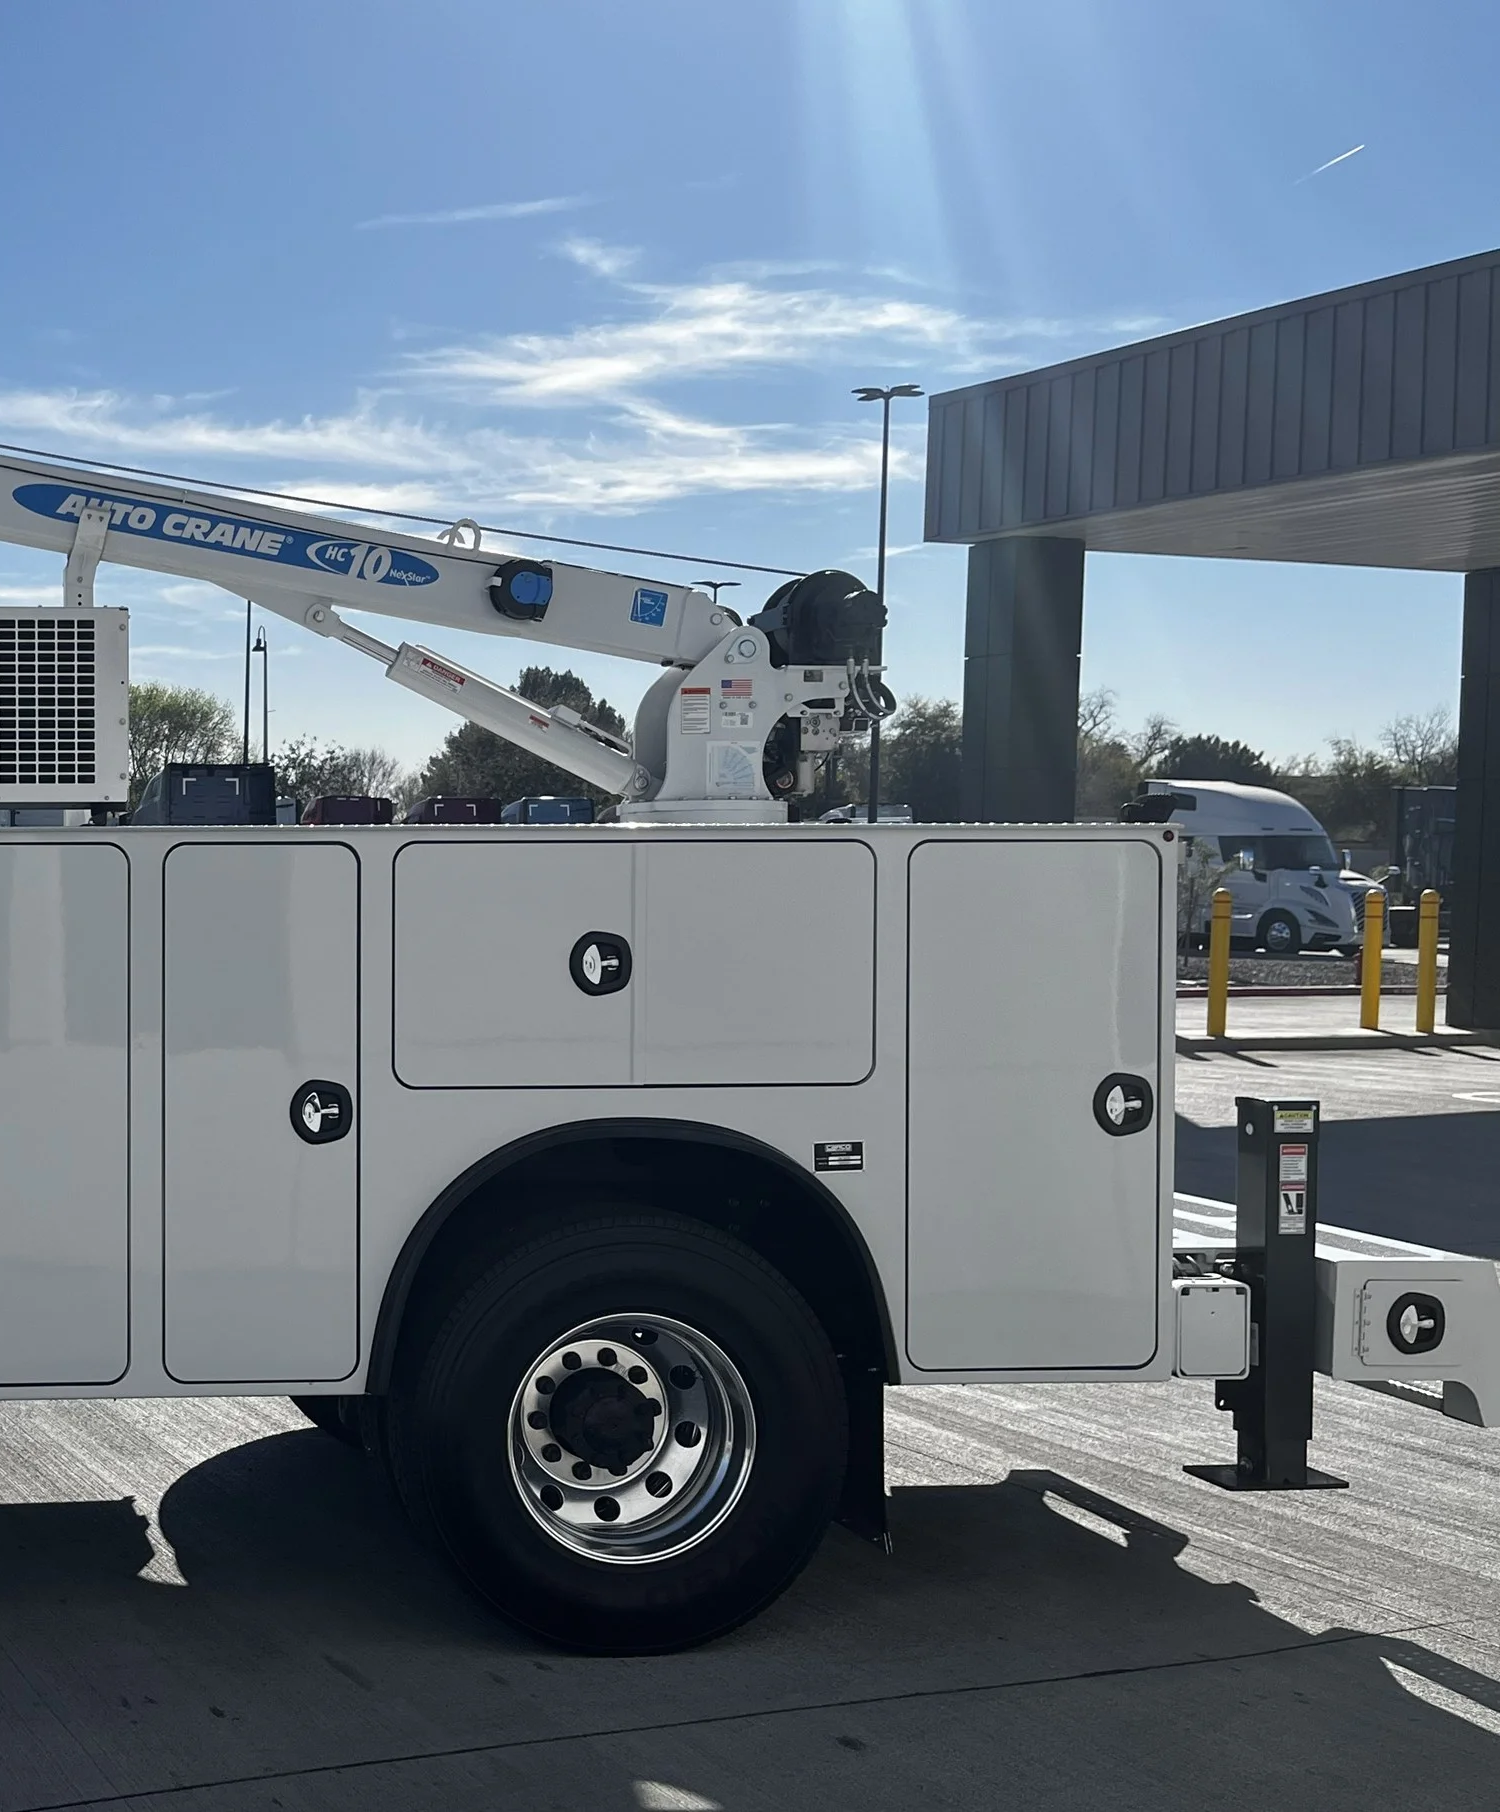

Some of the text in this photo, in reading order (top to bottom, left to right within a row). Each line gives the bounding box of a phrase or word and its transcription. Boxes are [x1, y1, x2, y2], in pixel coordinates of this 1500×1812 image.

[325, 546, 349, 561] HC
[347, 543, 392, 583] 10
[433, 665, 461, 682] DANGER
